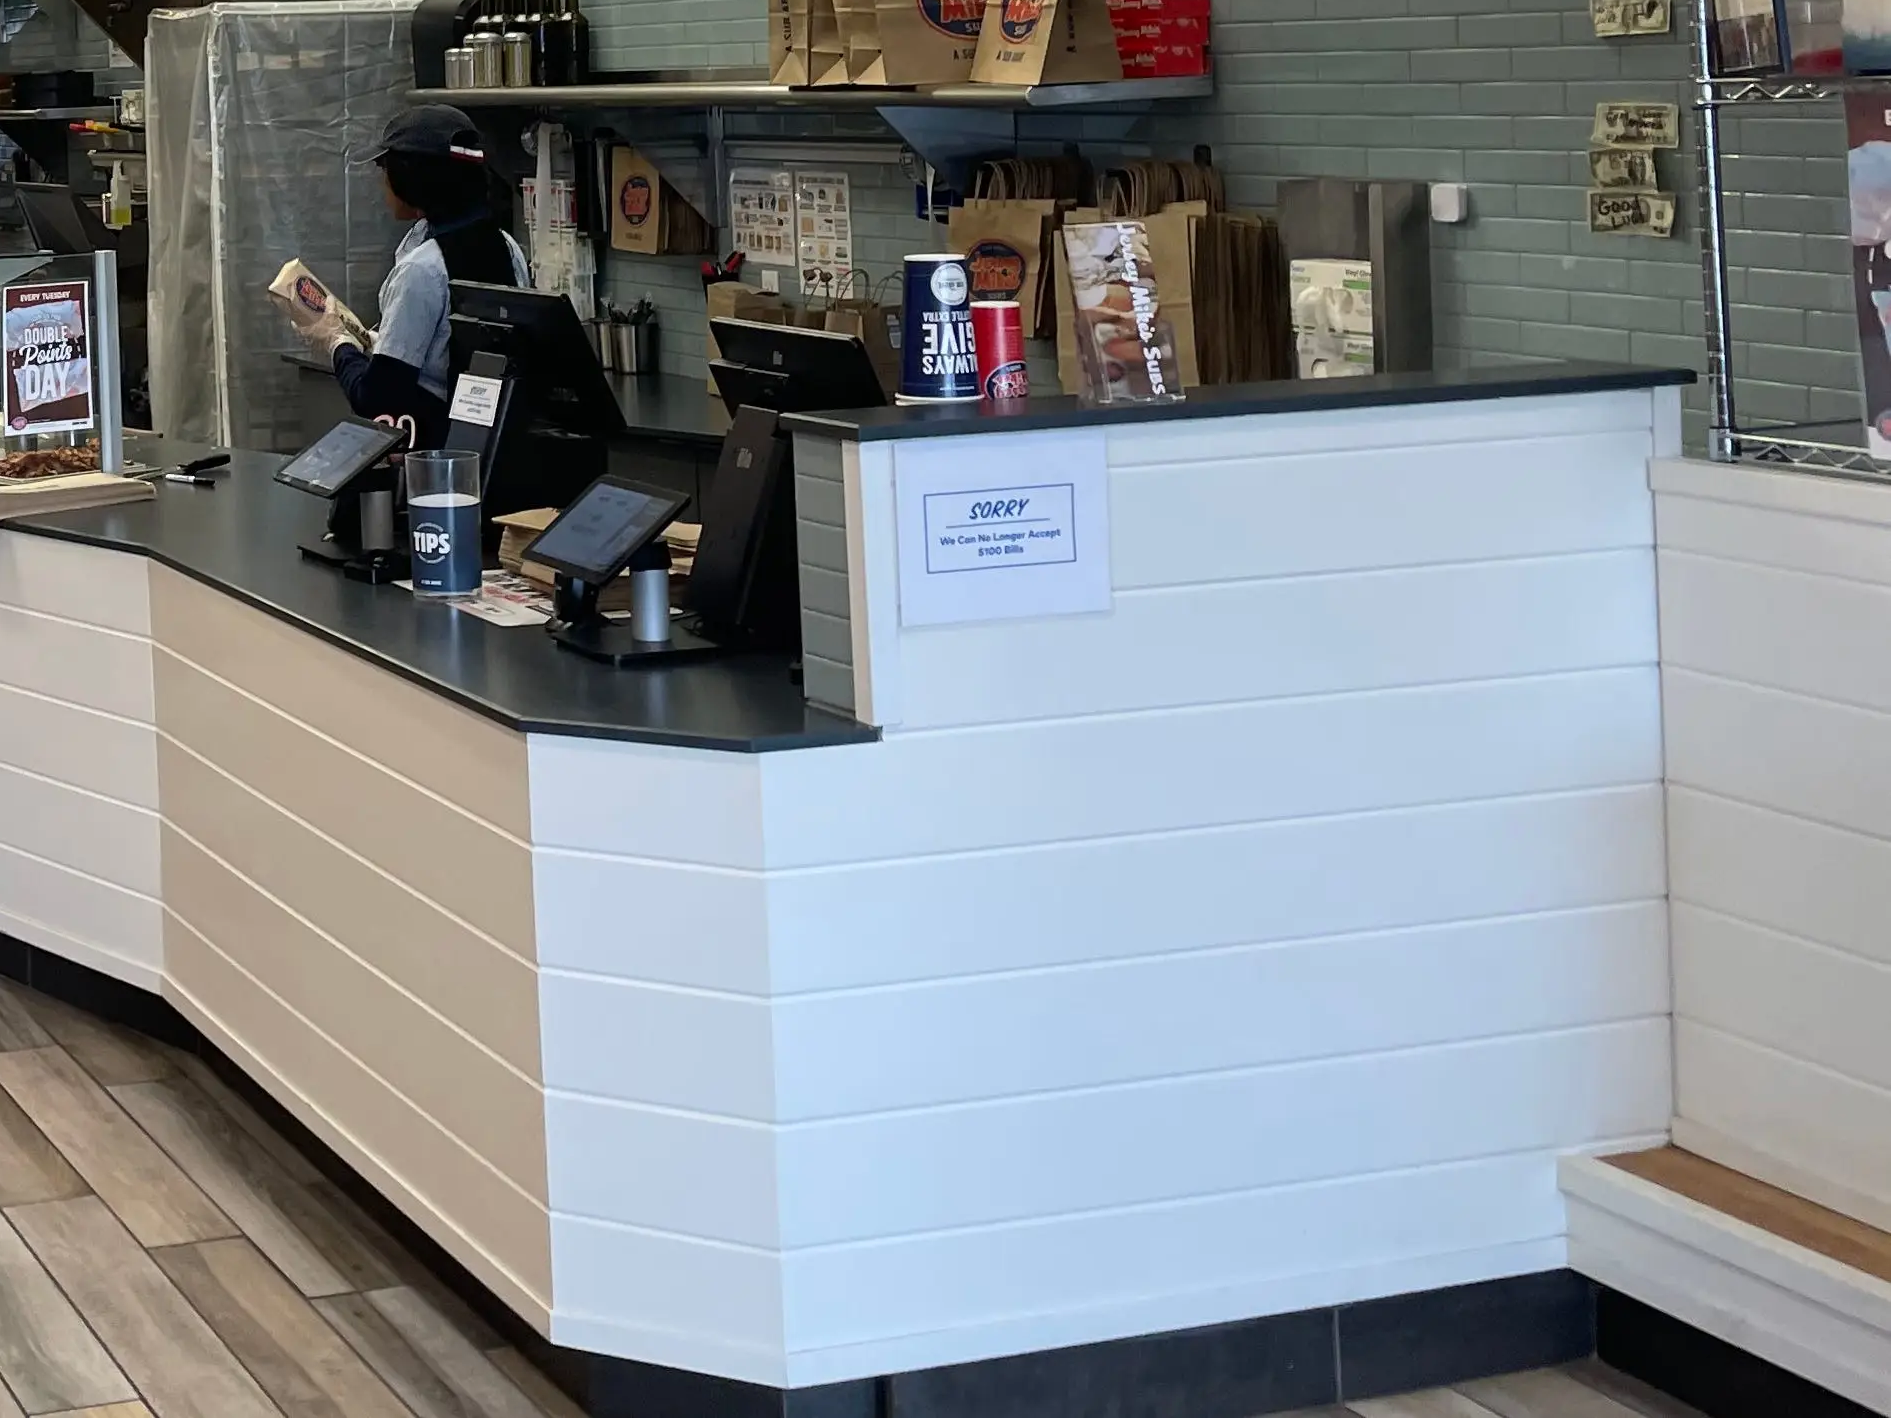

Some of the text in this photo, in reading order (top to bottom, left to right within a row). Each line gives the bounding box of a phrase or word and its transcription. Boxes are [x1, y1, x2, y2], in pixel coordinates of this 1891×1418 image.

[20, 290, 71, 302] EVERY TUESDAY
[922, 311, 950, 323] EXTRA
[24, 325, 68, 345] DOUBLE
[922, 322, 977, 354] GIVE
[1129, 285, 1154, 344] Mike's
[1142, 345, 1166, 396] Subs
[19, 341, 73, 369] Points
[25, 362, 70, 400] DAY
[969, 498, 1030, 520] SORRY
[413, 531, 451, 555] TIPS
[940, 528, 1061, 546] We Can No Longer Accept
[978, 544, 1024, 557] $100 Bills
